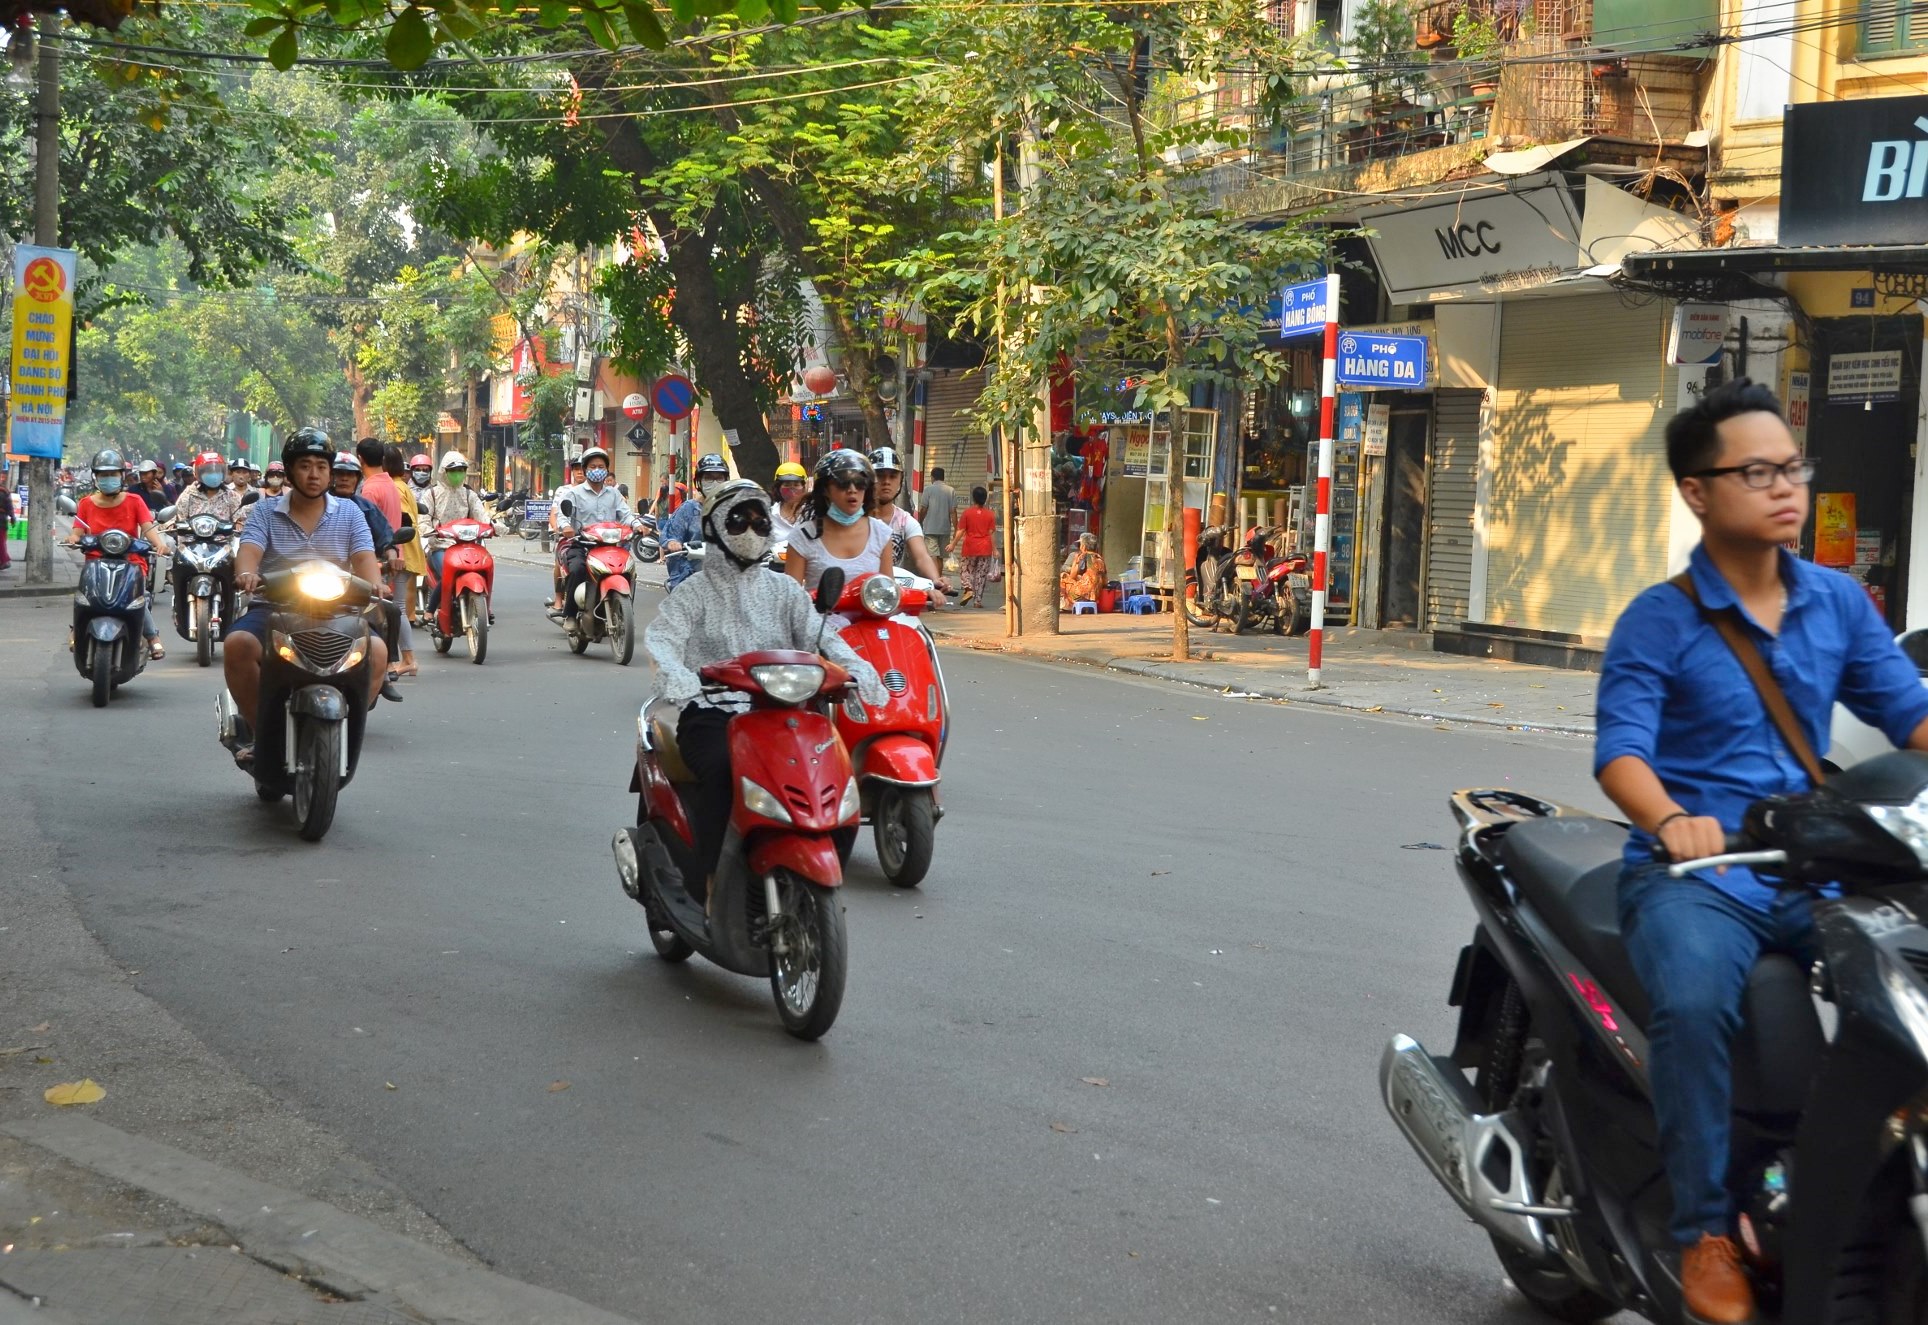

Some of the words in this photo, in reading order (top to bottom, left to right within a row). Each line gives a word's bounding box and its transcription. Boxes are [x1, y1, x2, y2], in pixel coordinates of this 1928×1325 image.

[1434, 220, 1502, 260] MCC
[1301, 287, 1316, 302] PHỐ
[1285, 306, 1305, 328] HÀNG
[1681, 328, 1722, 341] mobifone
[1371, 341, 1398, 355] PHỐ
[1344, 354, 1389, 378] HÀNG
[1393, 360, 1415, 379] DA
[1686, 381, 1698, 394] 96
